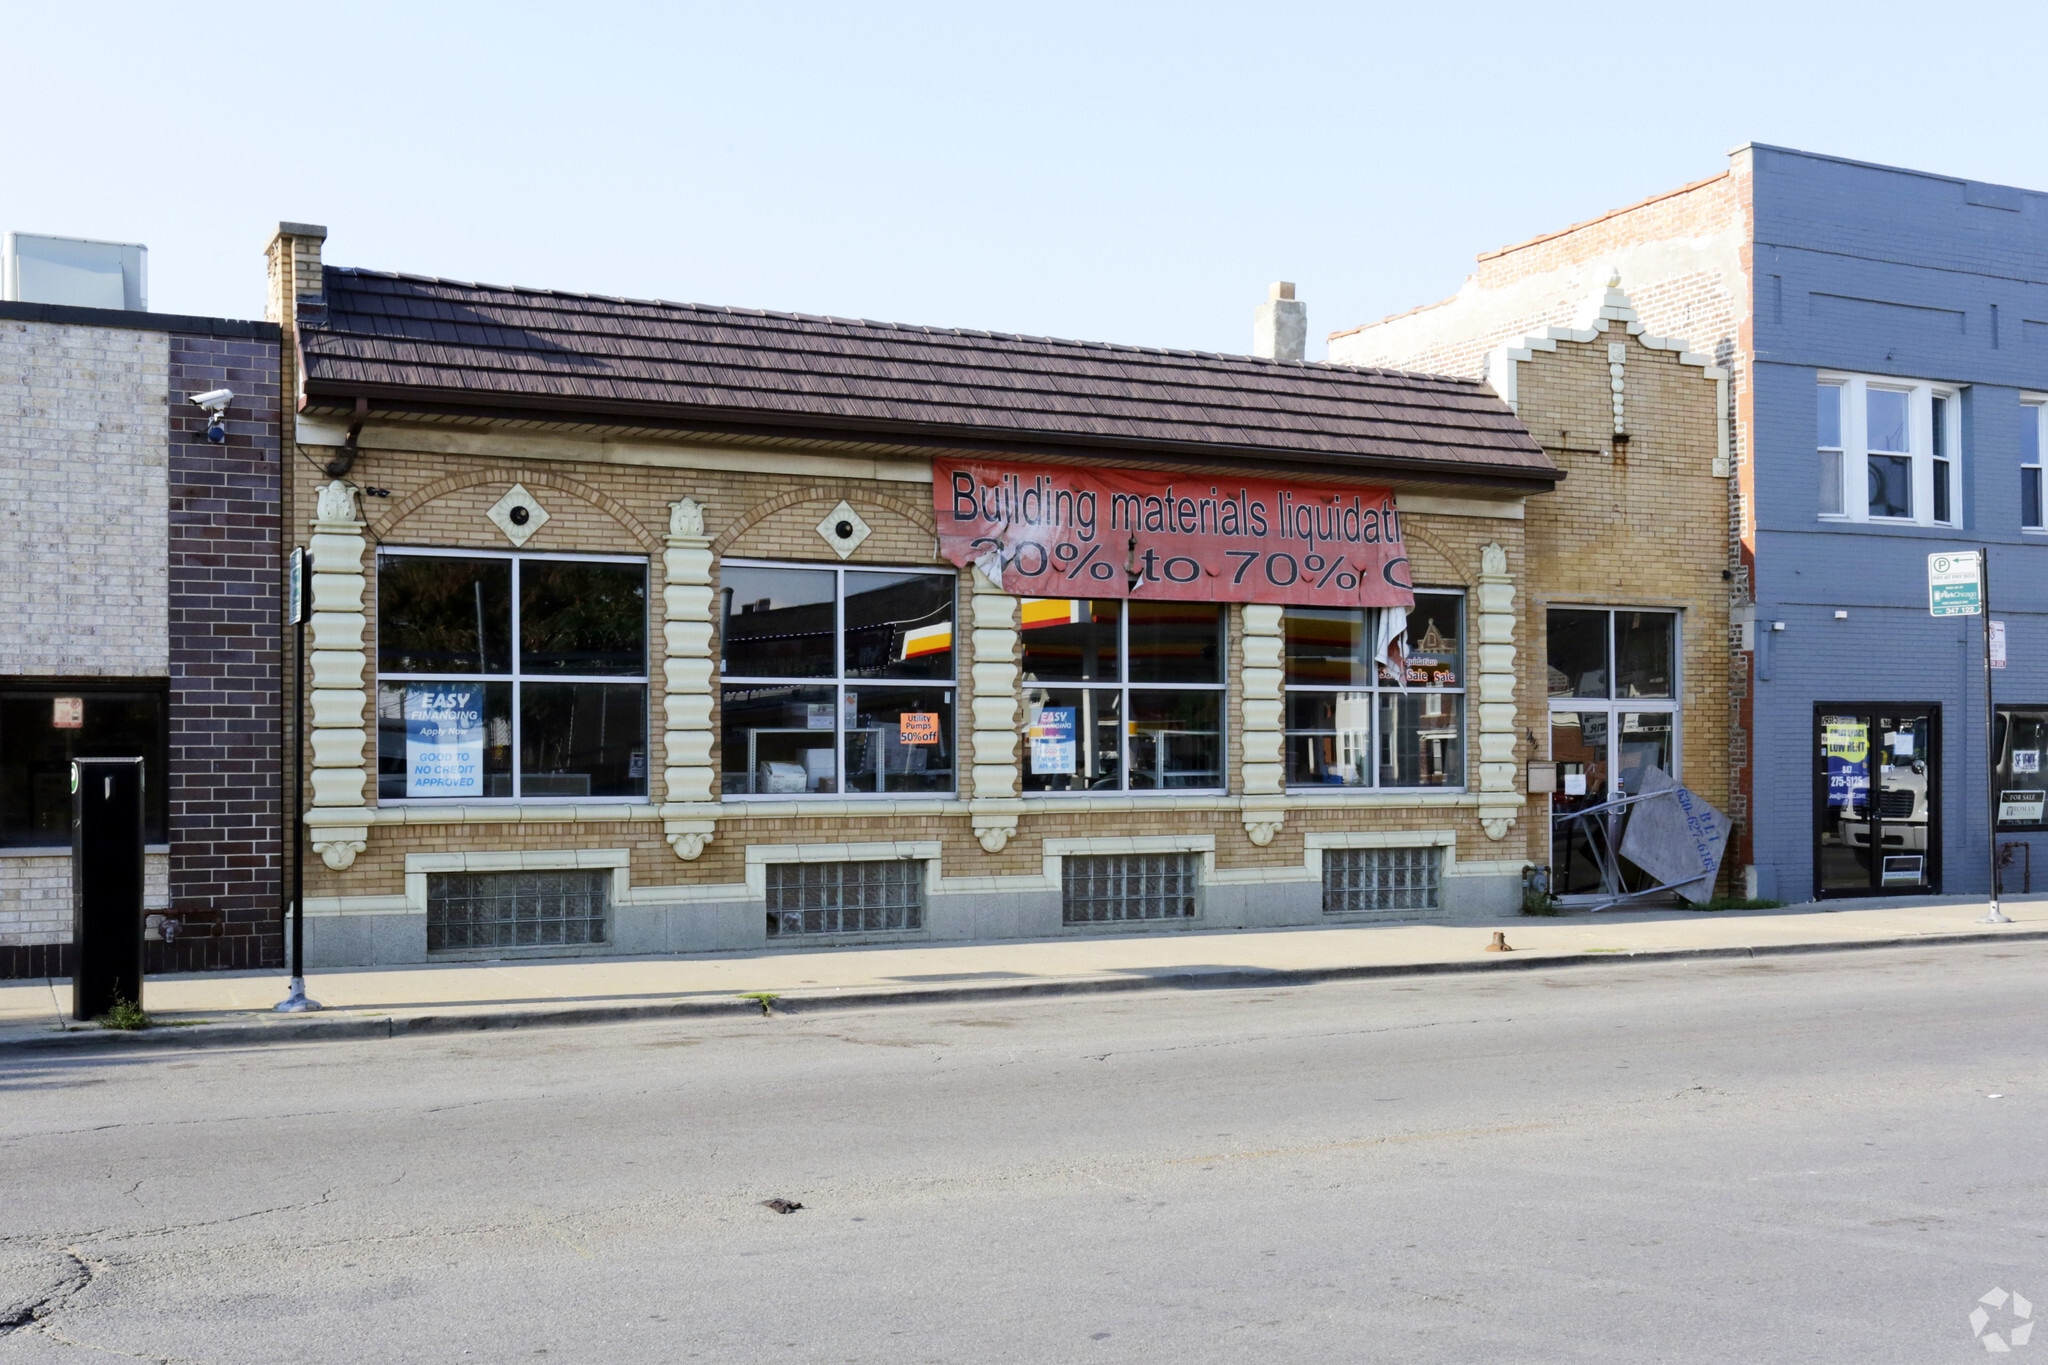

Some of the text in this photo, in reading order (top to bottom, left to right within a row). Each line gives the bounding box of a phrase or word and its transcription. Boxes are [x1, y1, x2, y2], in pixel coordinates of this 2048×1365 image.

[952, 470, 1400, 552] Building materials liquidati
[1141, 548, 1200, 583] to
[1225, 551, 1358, 590] 70%
[1407, 669, 1428, 681] Sale
[1434, 670, 1455, 682] Sale
[421, 693, 470, 708] EASY
[411, 711, 478, 720] FINANCING
[908, 715, 931, 723] Utility
[1040, 712, 1067, 721] EASY
[420, 728, 446, 736] Apply
[901, 732, 936, 741] 50% off
[419, 753, 470, 761] GOOD TO
[414, 765, 475, 774] NO CREDIT
[415, 778, 475, 787] APPROVED
